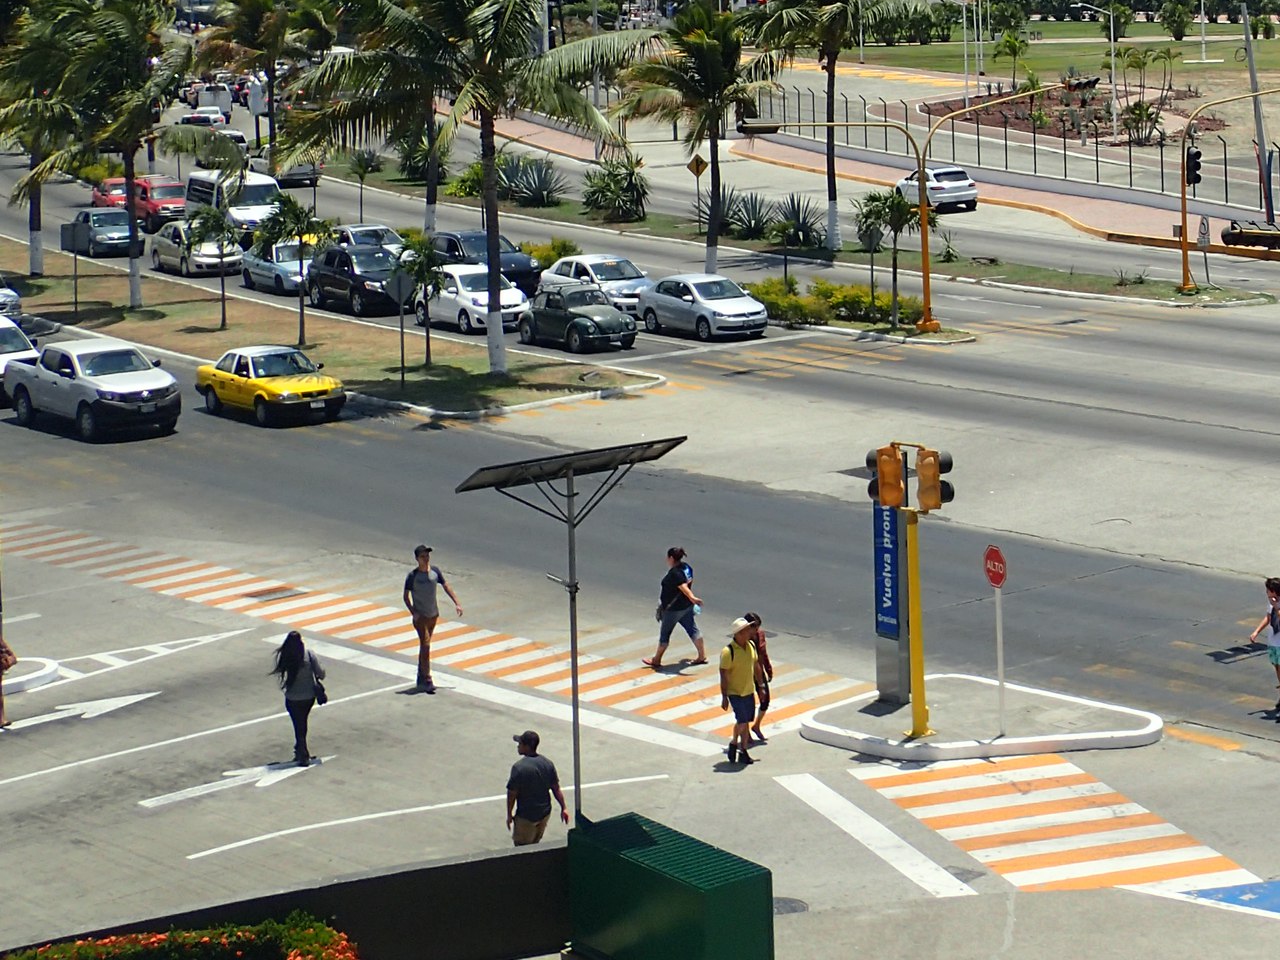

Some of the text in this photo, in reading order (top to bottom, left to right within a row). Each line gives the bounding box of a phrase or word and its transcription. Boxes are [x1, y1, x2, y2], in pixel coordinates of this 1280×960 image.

[881, 505, 893, 608] Vuelva pront
[986, 559, 1004, 574] ALTO
